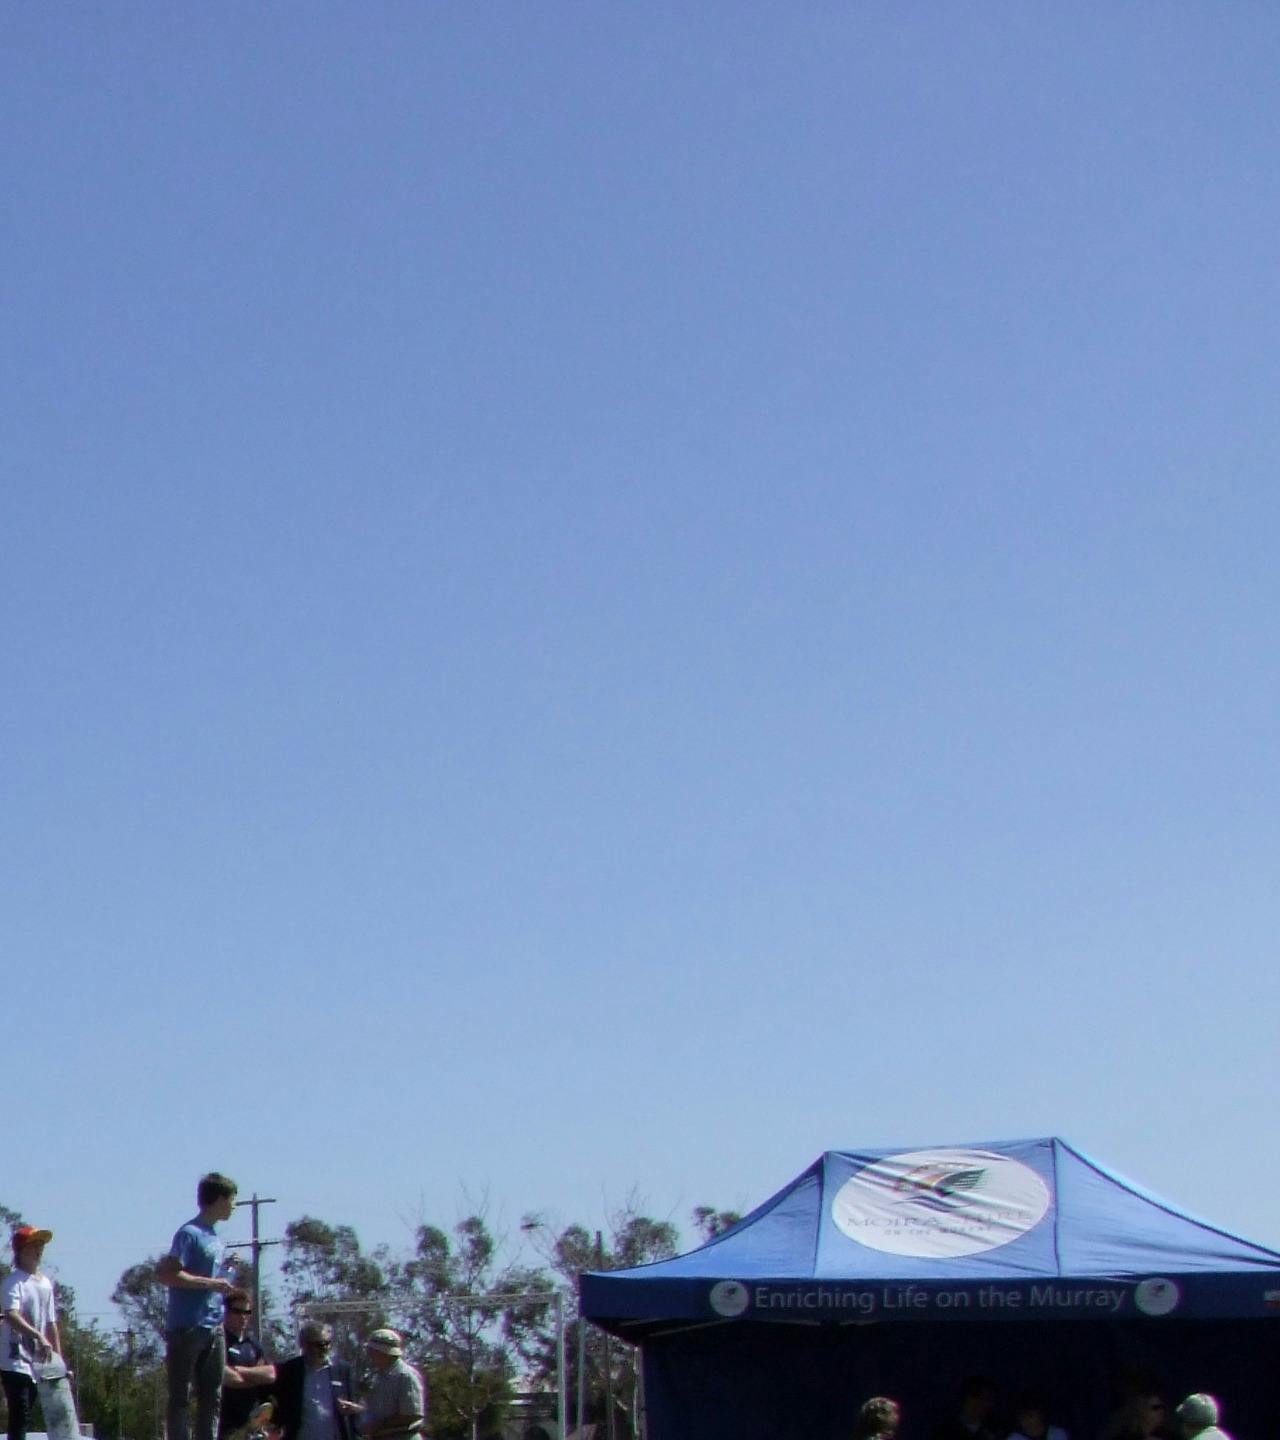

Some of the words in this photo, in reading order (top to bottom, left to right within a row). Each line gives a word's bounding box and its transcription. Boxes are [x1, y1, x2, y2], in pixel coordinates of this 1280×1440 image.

[755, 1286, 875, 1314] Enriching
[883, 1286, 929, 1308] Life
[936, 1293, 969, 1309] on
[979, 1286, 1023, 1308] the
[1030, 1285, 1128, 1312] Murray
